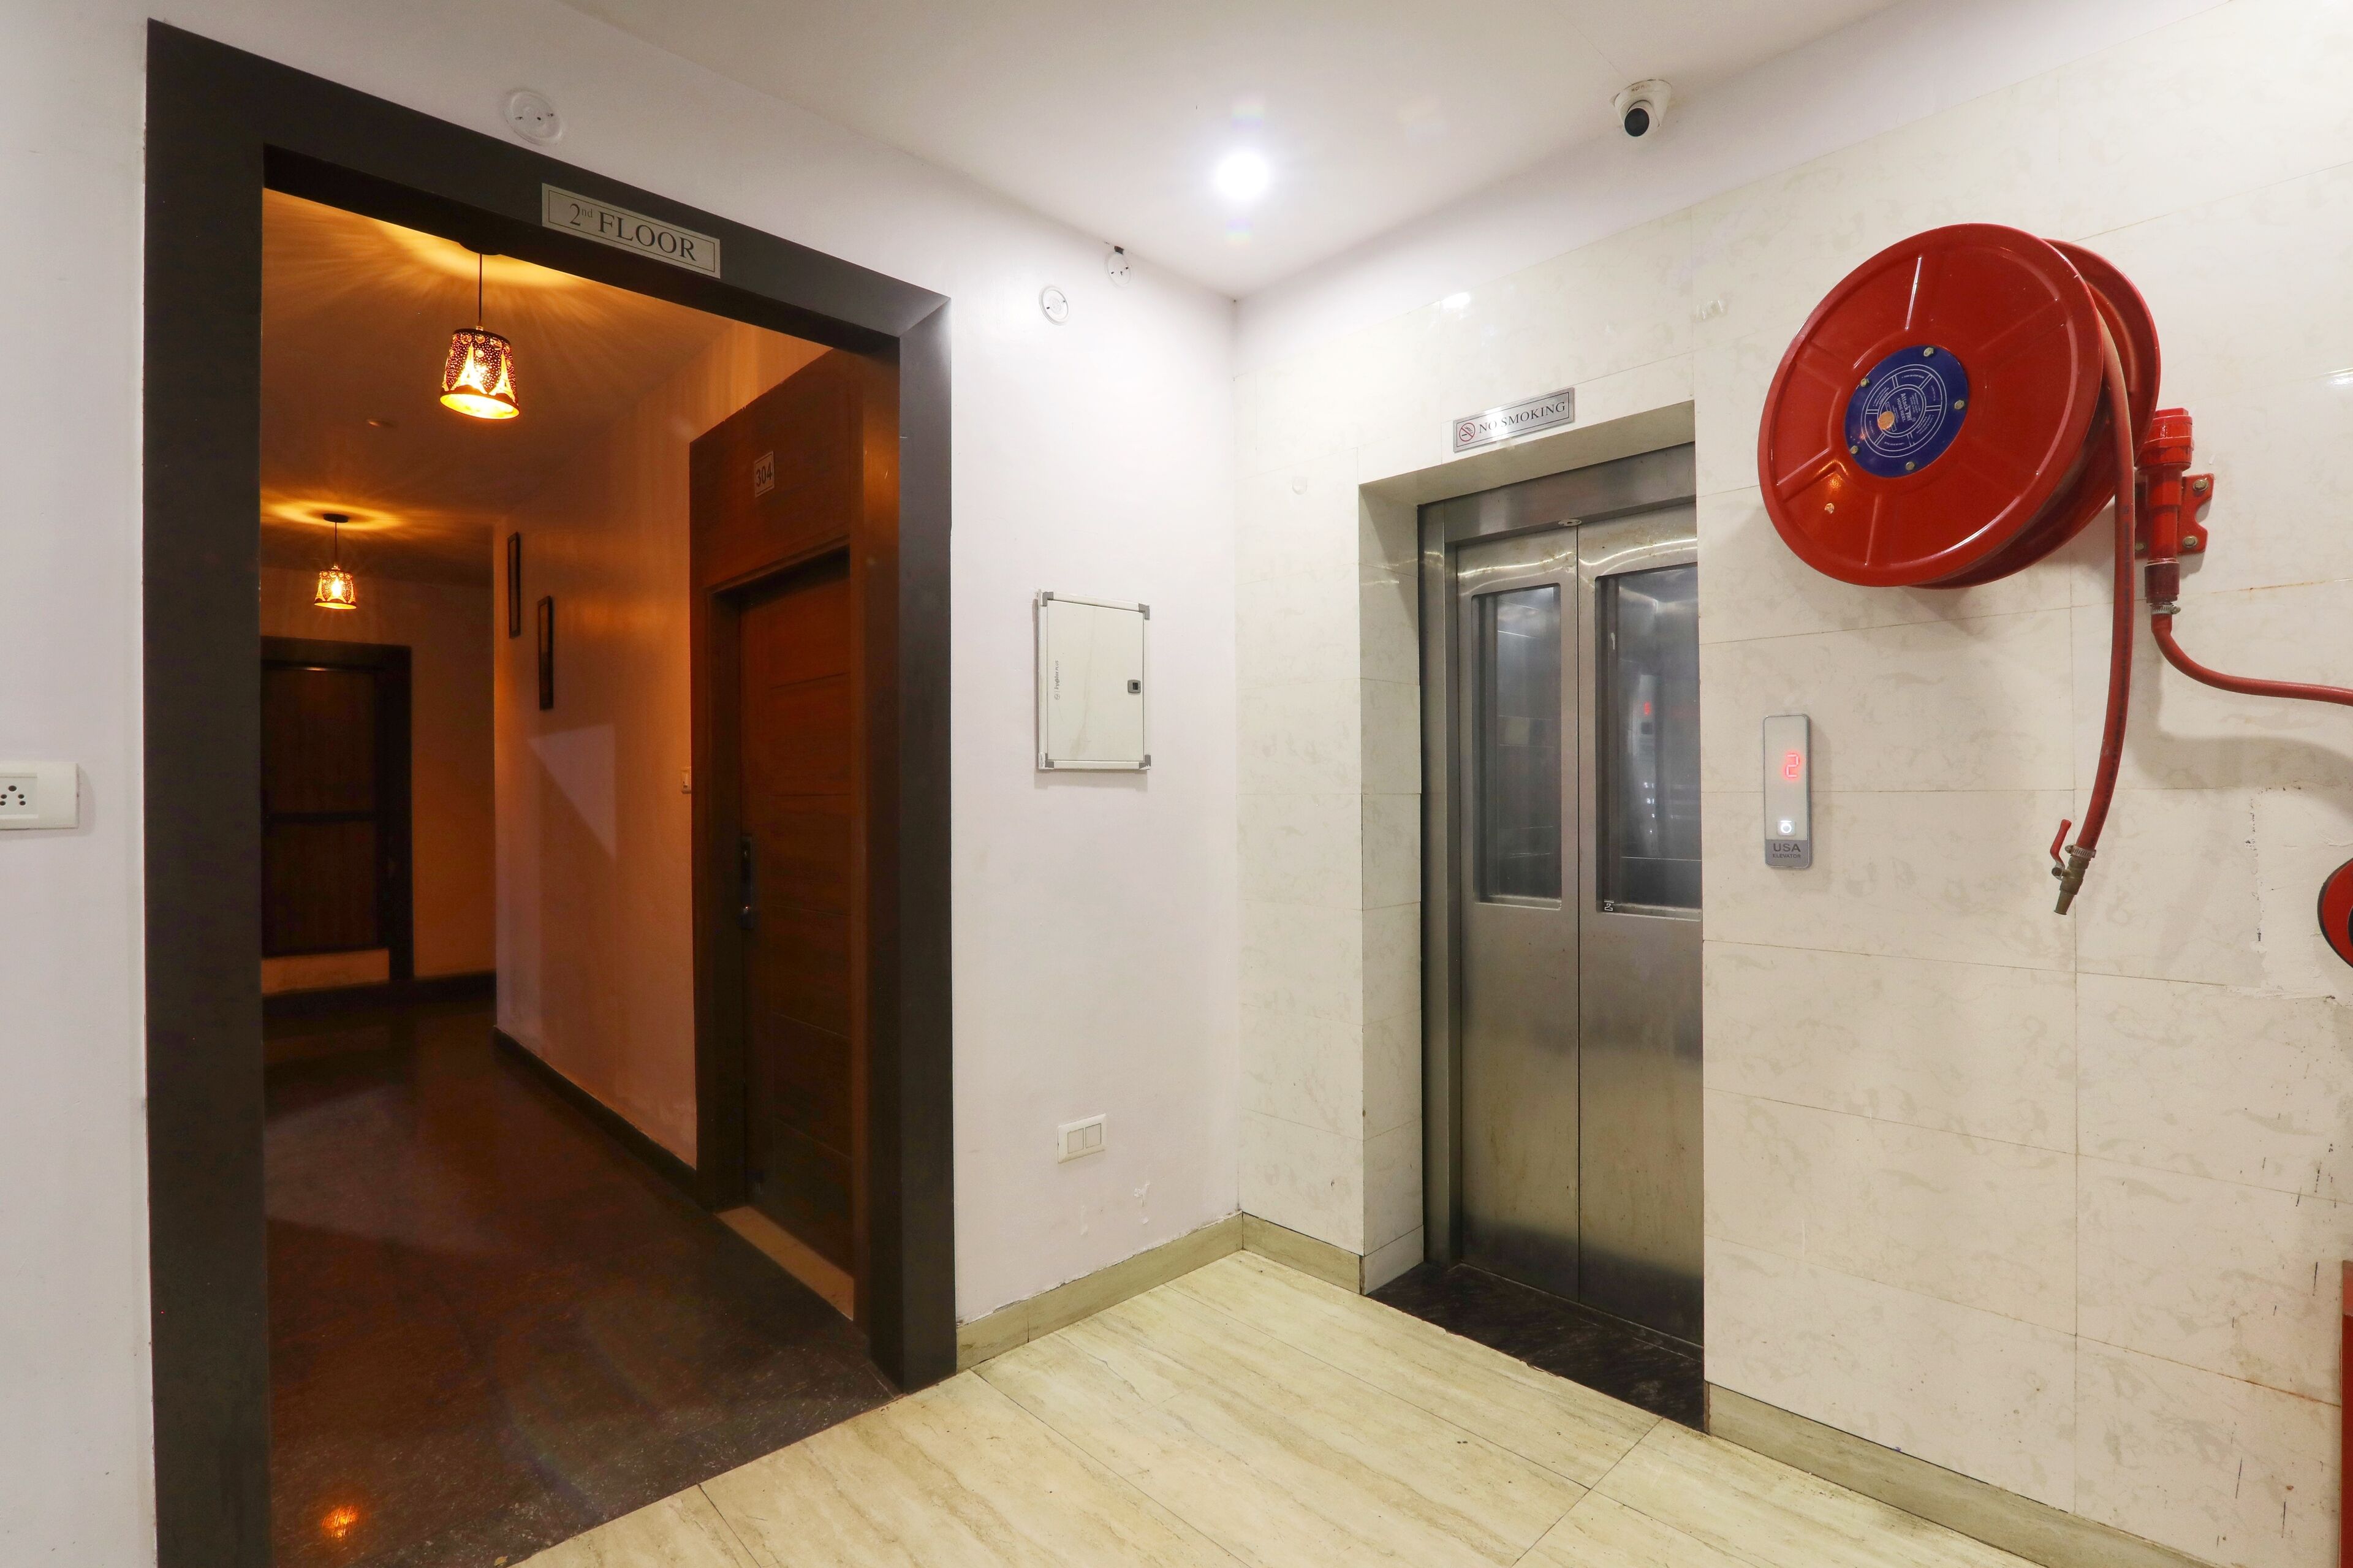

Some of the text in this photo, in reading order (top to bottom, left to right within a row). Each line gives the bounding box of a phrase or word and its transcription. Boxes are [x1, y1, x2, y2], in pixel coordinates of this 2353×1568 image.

[569, 203, 697, 262] 2nd FLOOR
[1479, 401, 1566, 434] NO SMOKING
[756, 461, 772, 487] 304
[1785, 754, 1800, 778] 2
[1773, 843, 1802, 852] USA
